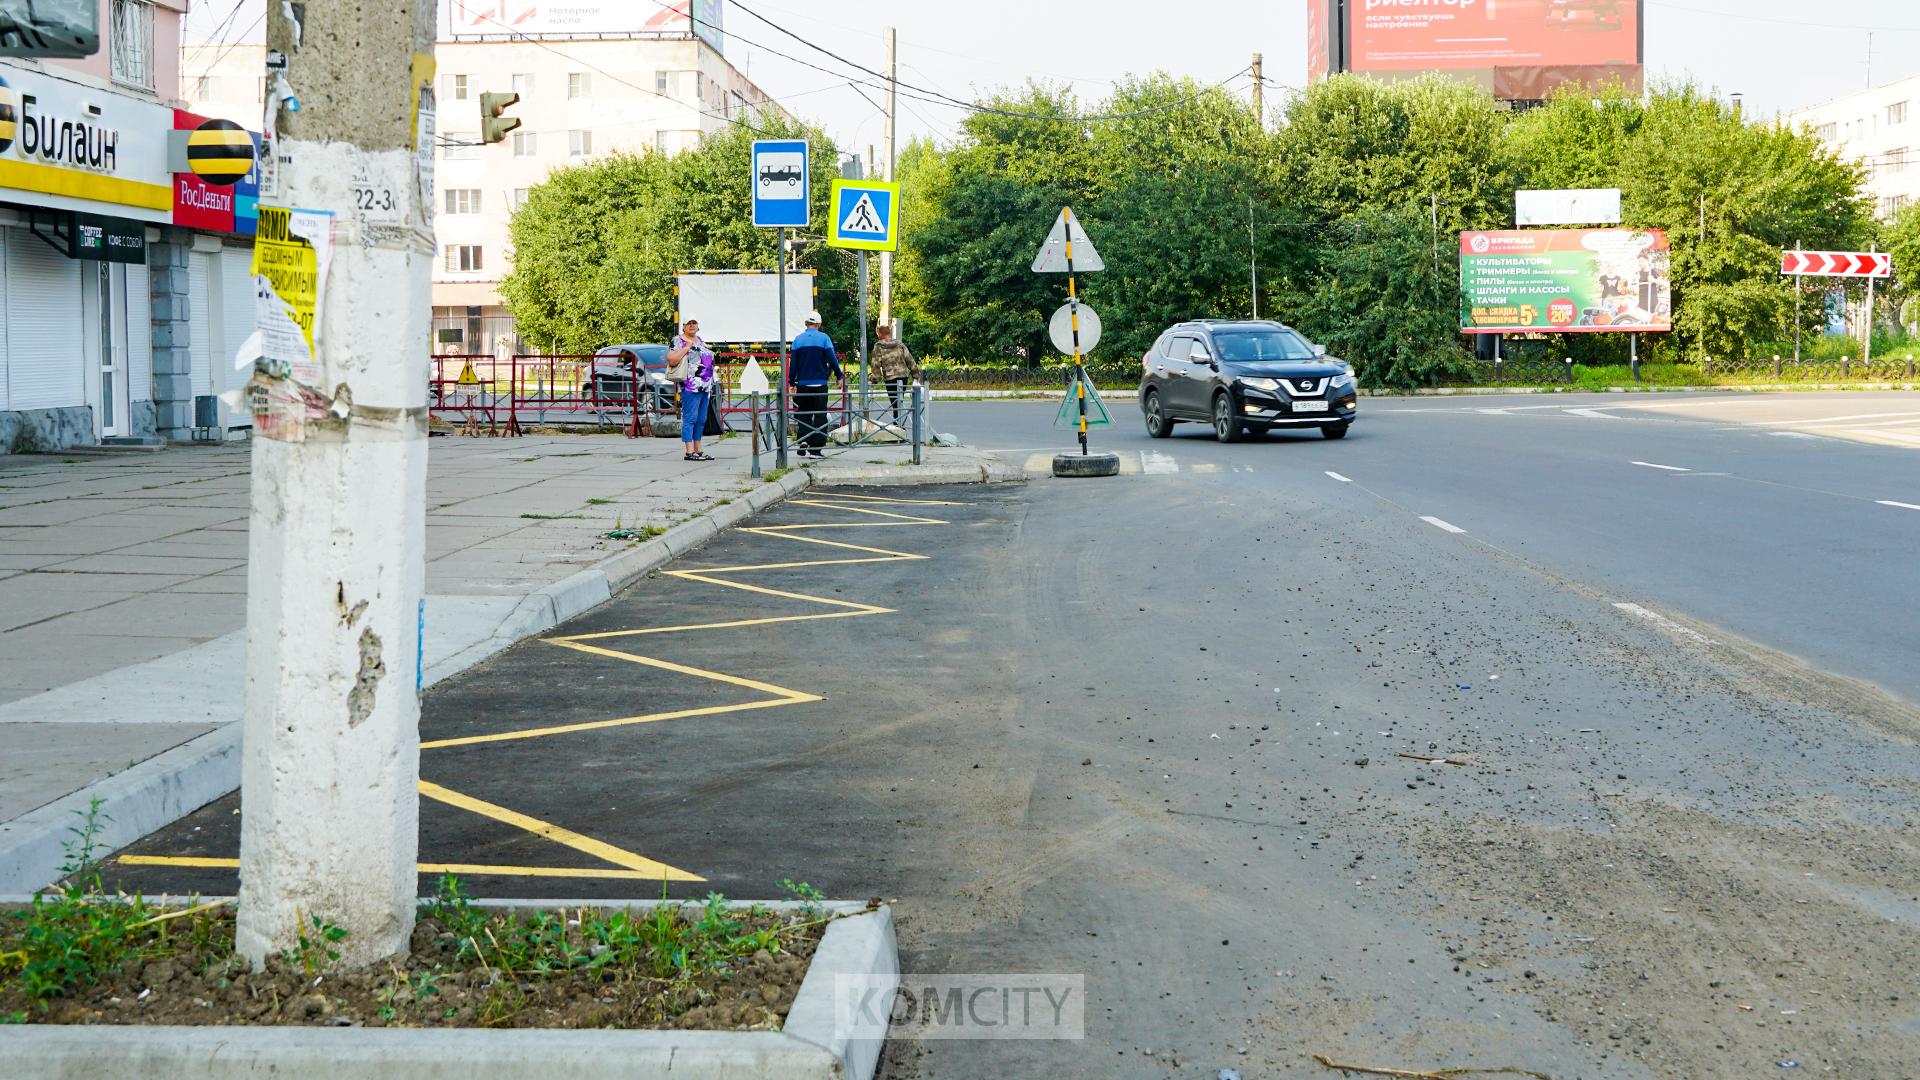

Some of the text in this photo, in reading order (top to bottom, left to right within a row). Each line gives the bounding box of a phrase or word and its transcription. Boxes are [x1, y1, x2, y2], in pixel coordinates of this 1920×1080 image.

[21, 93, 117, 171] Билайн
[181, 180, 231, 212] РосДеньги
[1476, 257, 1552, 265] КУЛЬТИВАТОРЫ
[1477, 296, 1507, 304] ТАЧКИ
[1490, 306, 1518, 315] СКИДКА
